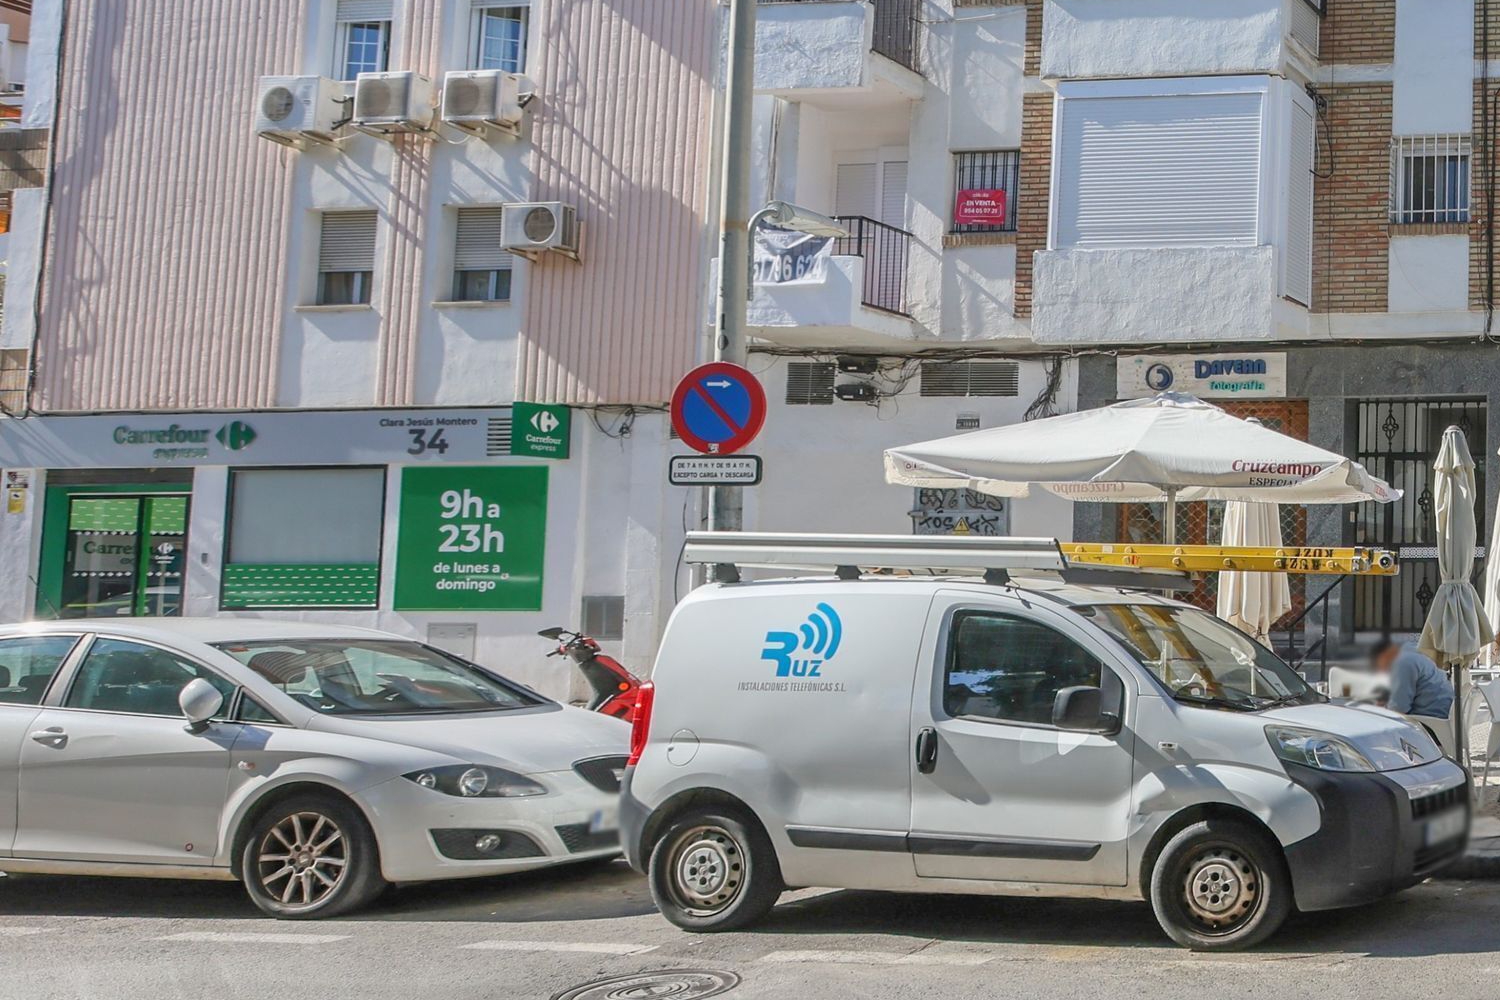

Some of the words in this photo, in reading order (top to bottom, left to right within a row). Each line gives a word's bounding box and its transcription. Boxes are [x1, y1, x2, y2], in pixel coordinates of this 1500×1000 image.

[379, 418, 405, 427] Clara
[406, 416, 434, 426] Jesús
[436, 416, 478, 426] Montero
[113, 423, 210, 445] Carrefour
[407, 427, 449, 456] 34
[525, 433, 562, 446] Carrefour
[530, 444, 557, 453] express
[1231, 459, 1322, 478] Cruzcampo
[440, 488, 483, 519] 9h
[486, 503, 501, 518] a
[438, 523, 505, 553] 23h
[83, 540, 132, 555] Carre
[433, 561, 451, 574] de
[453, 561, 490, 574] lunes
[491, 563, 501, 574] a
[435, 577, 497, 592] domingo
[737, 681, 789, 692] INSTALACIONES
[790, 681, 833, 692] TELEFÓNICAS
[833, 681, 847, 692] S.L.
